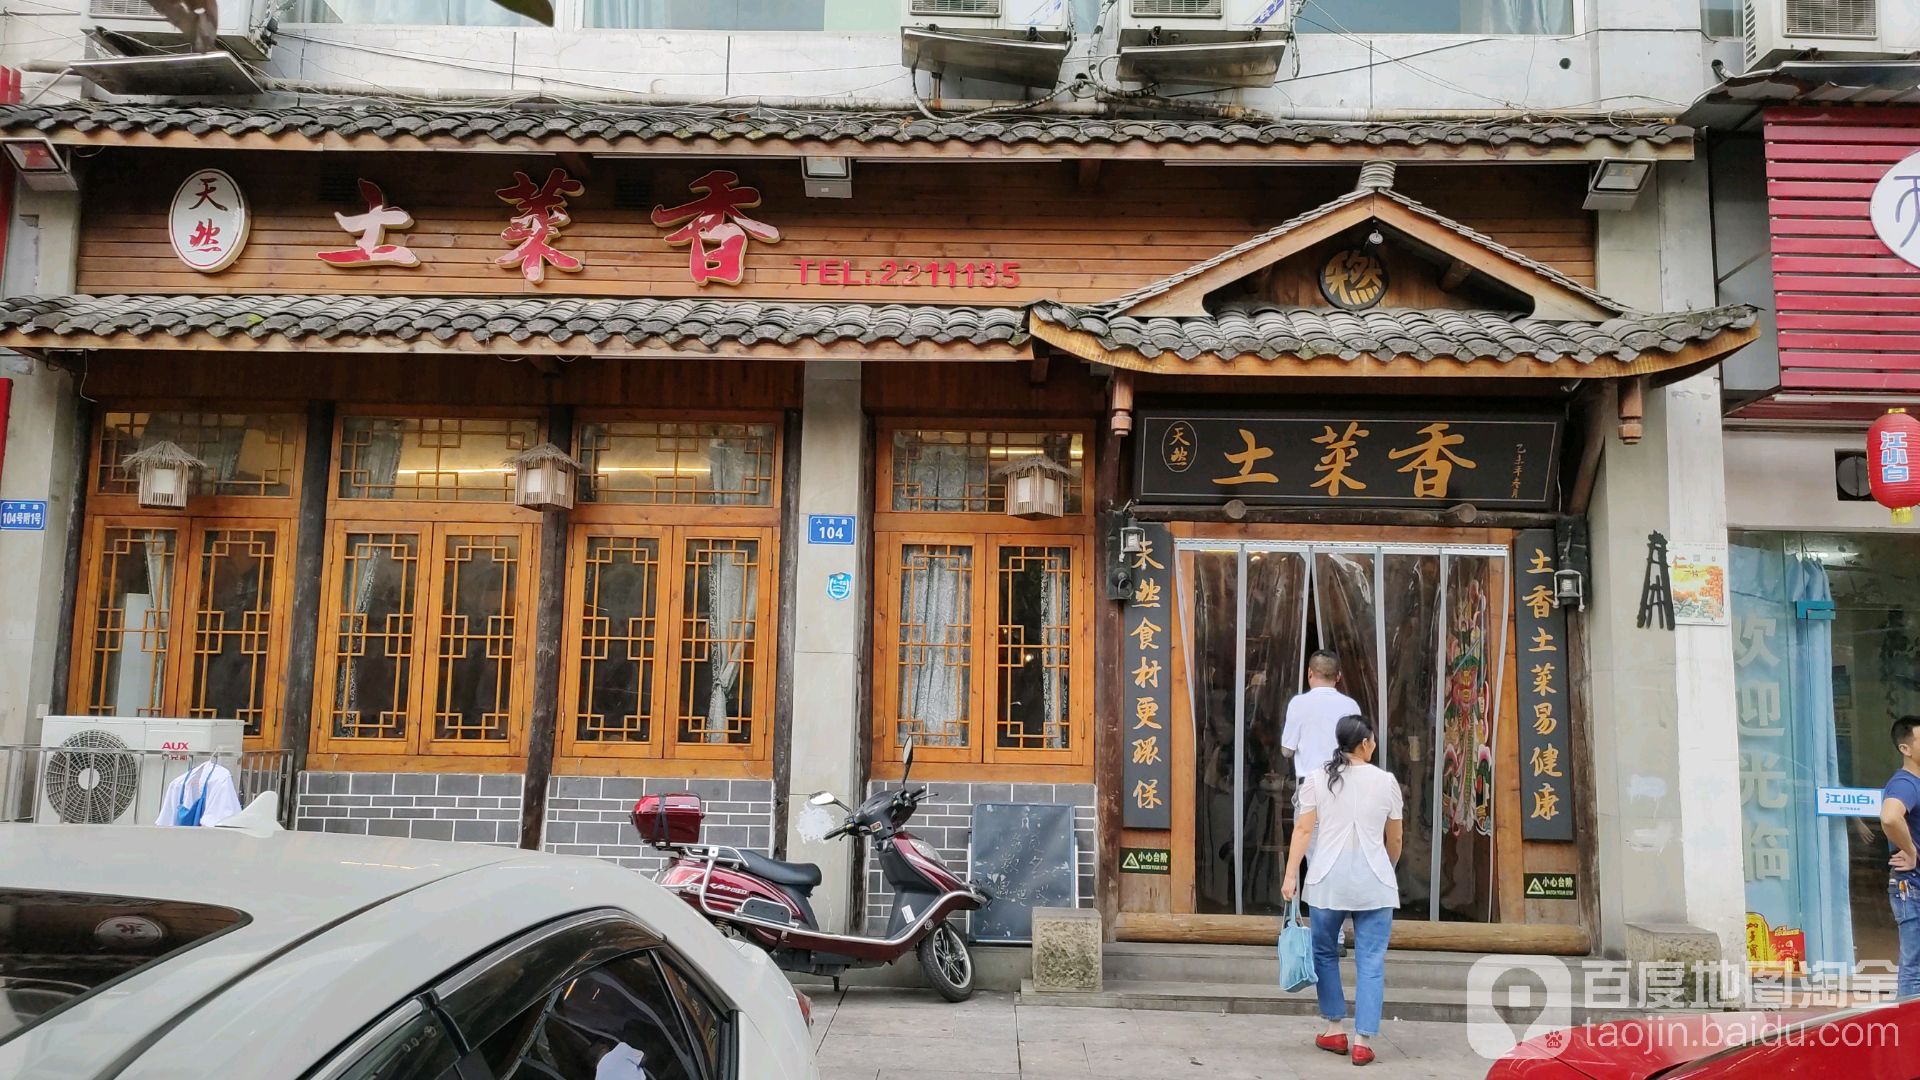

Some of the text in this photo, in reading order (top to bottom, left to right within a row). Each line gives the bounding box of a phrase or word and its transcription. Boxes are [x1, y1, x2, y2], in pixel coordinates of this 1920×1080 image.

[187, 177, 229, 252] 天然
[316, 167, 781, 287] 土菜香
[1168, 426, 1191, 466] 天然
[1880, 431, 1909, 483] 江小白
[1212, 421, 1477, 498] 土菜香
[819, 526, 844, 539] 104
[162, 742, 188, 750] AUX
[1825, 793, 1870, 804] 江小白
[1138, 851, 1168, 863] 小心台阶
[1542, 876, 1573, 888] 小心台阶
